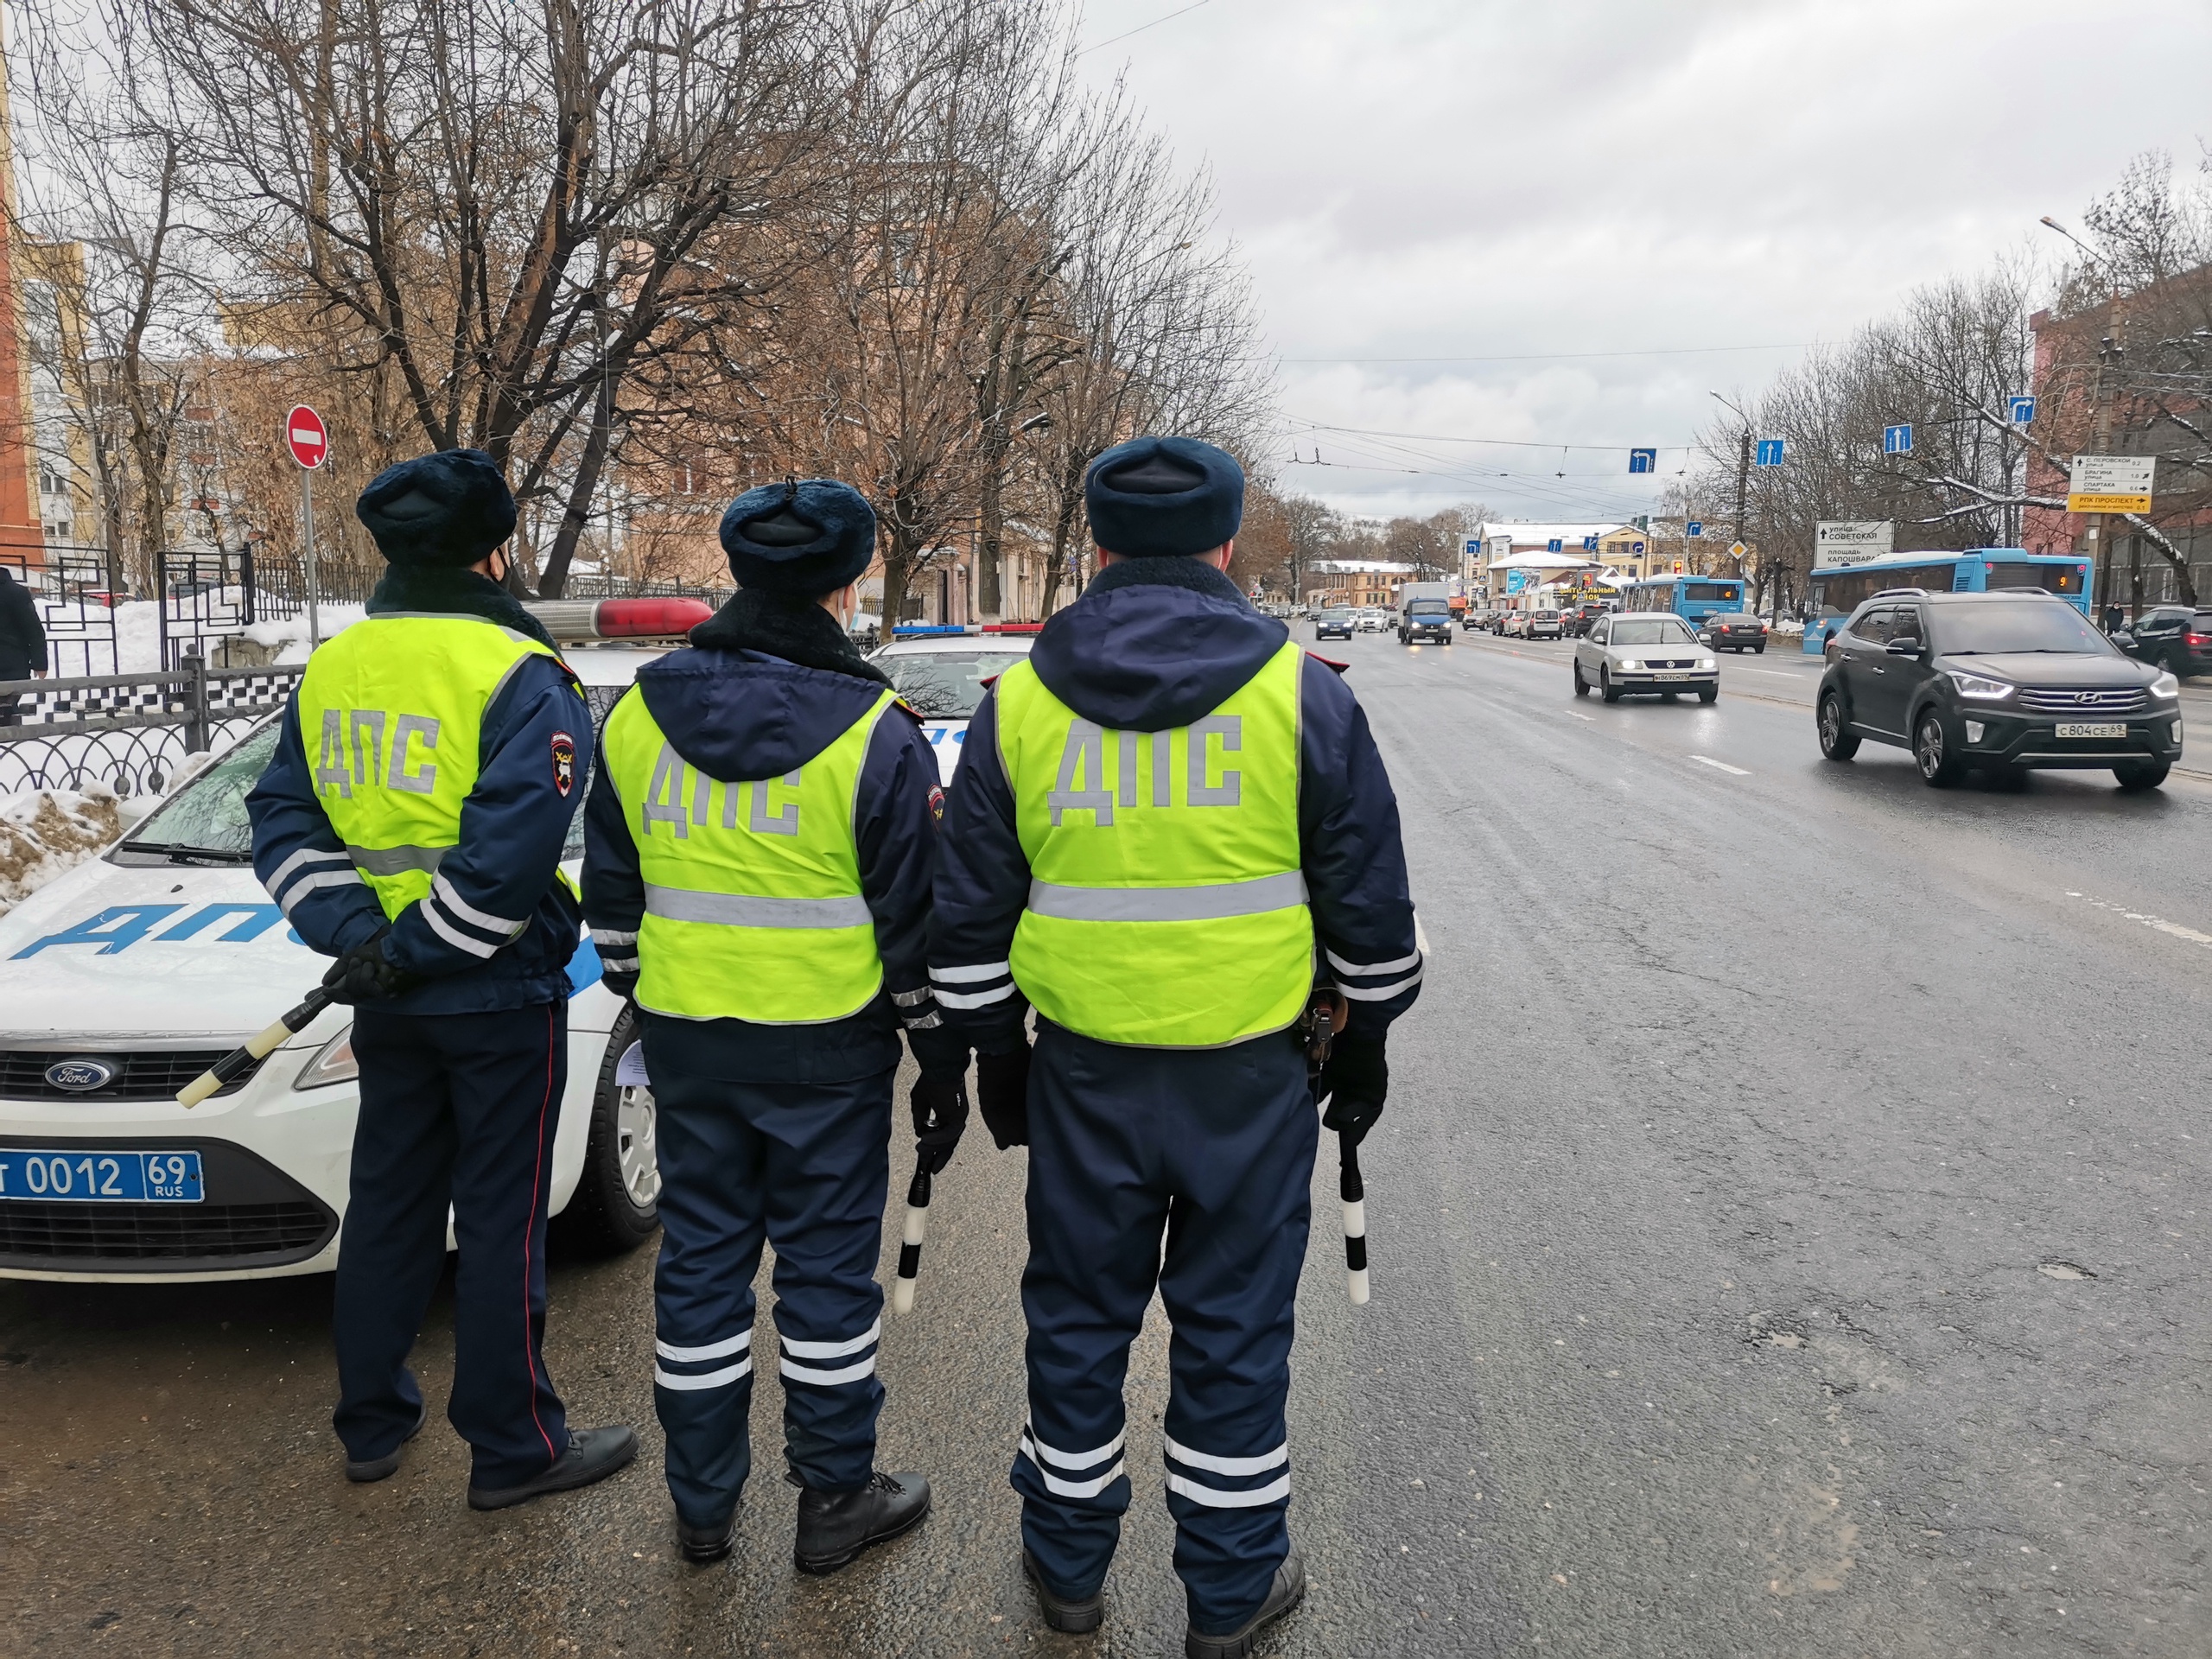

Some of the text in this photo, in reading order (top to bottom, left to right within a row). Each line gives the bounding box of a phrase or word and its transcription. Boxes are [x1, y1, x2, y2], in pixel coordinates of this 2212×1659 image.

[2060, 576, 2067, 587] 9
[315, 709, 440, 798] ДПС
[1046, 715, 1242, 827] ДПС
[7, 903, 307, 961] ДП
[57, 1067, 92, 1084] Ford
[148, 1156, 186, 1185] 69
[155, 1186, 183, 1197] RUS
